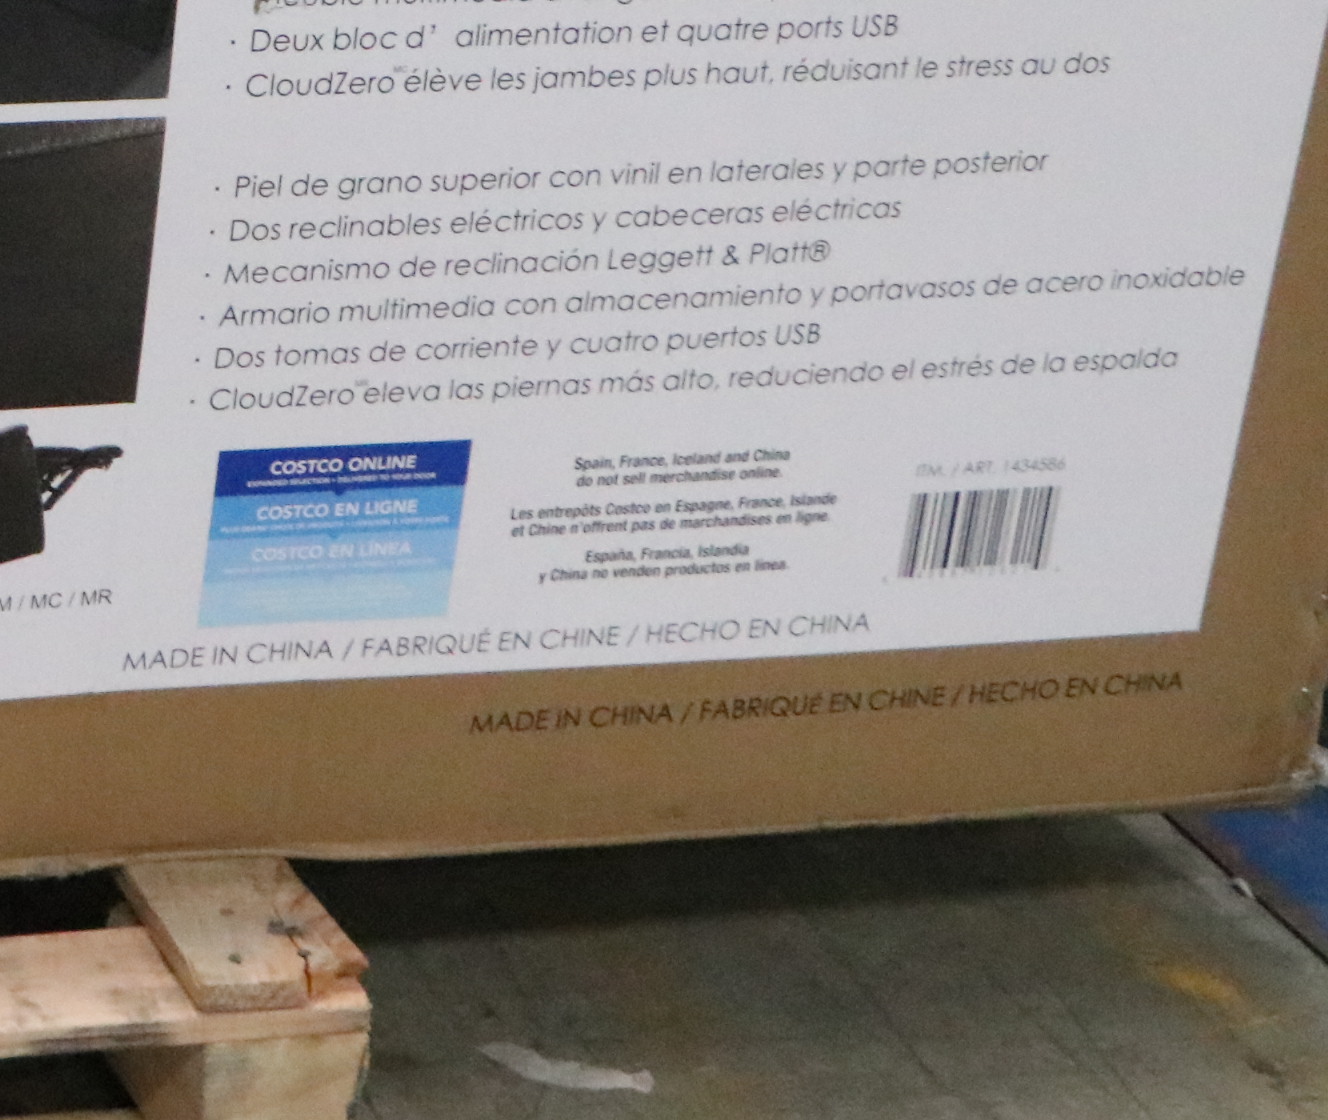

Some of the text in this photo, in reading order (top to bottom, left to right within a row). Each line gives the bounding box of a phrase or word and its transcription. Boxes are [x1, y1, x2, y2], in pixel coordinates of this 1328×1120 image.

[229, 198, 901, 242] Dos reclinables eléctricos y cabeceras eléctricas
[224, 259, 390, 284] Mecanismo
[398, 256, 437, 278] de
[444, 248, 599, 276] reclinación
[607, 245, 714, 274] Leggett
[721, 244, 739, 266] &
[269, 454, 418, 476] COSTCO ONLINE
[574, 449, 791, 472] Spain, France, Iceland and China
[576, 467, 782, 487] do not sell merchandise online.
[256, 498, 419, 521] COSTCO EN LIGNE
[122, 646, 205, 671] MADE
[212, 646, 238, 665] IN
[246, 639, 334, 665] CHINA
[361, 628, 491, 658] FABRIQUÉ
[497, 631, 532, 652] EN
[539, 625, 620, 650] CHINE
[646, 619, 741, 644] HECHO
[748, 618, 781, 639] EN
[788, 613, 870, 637] CHINA
